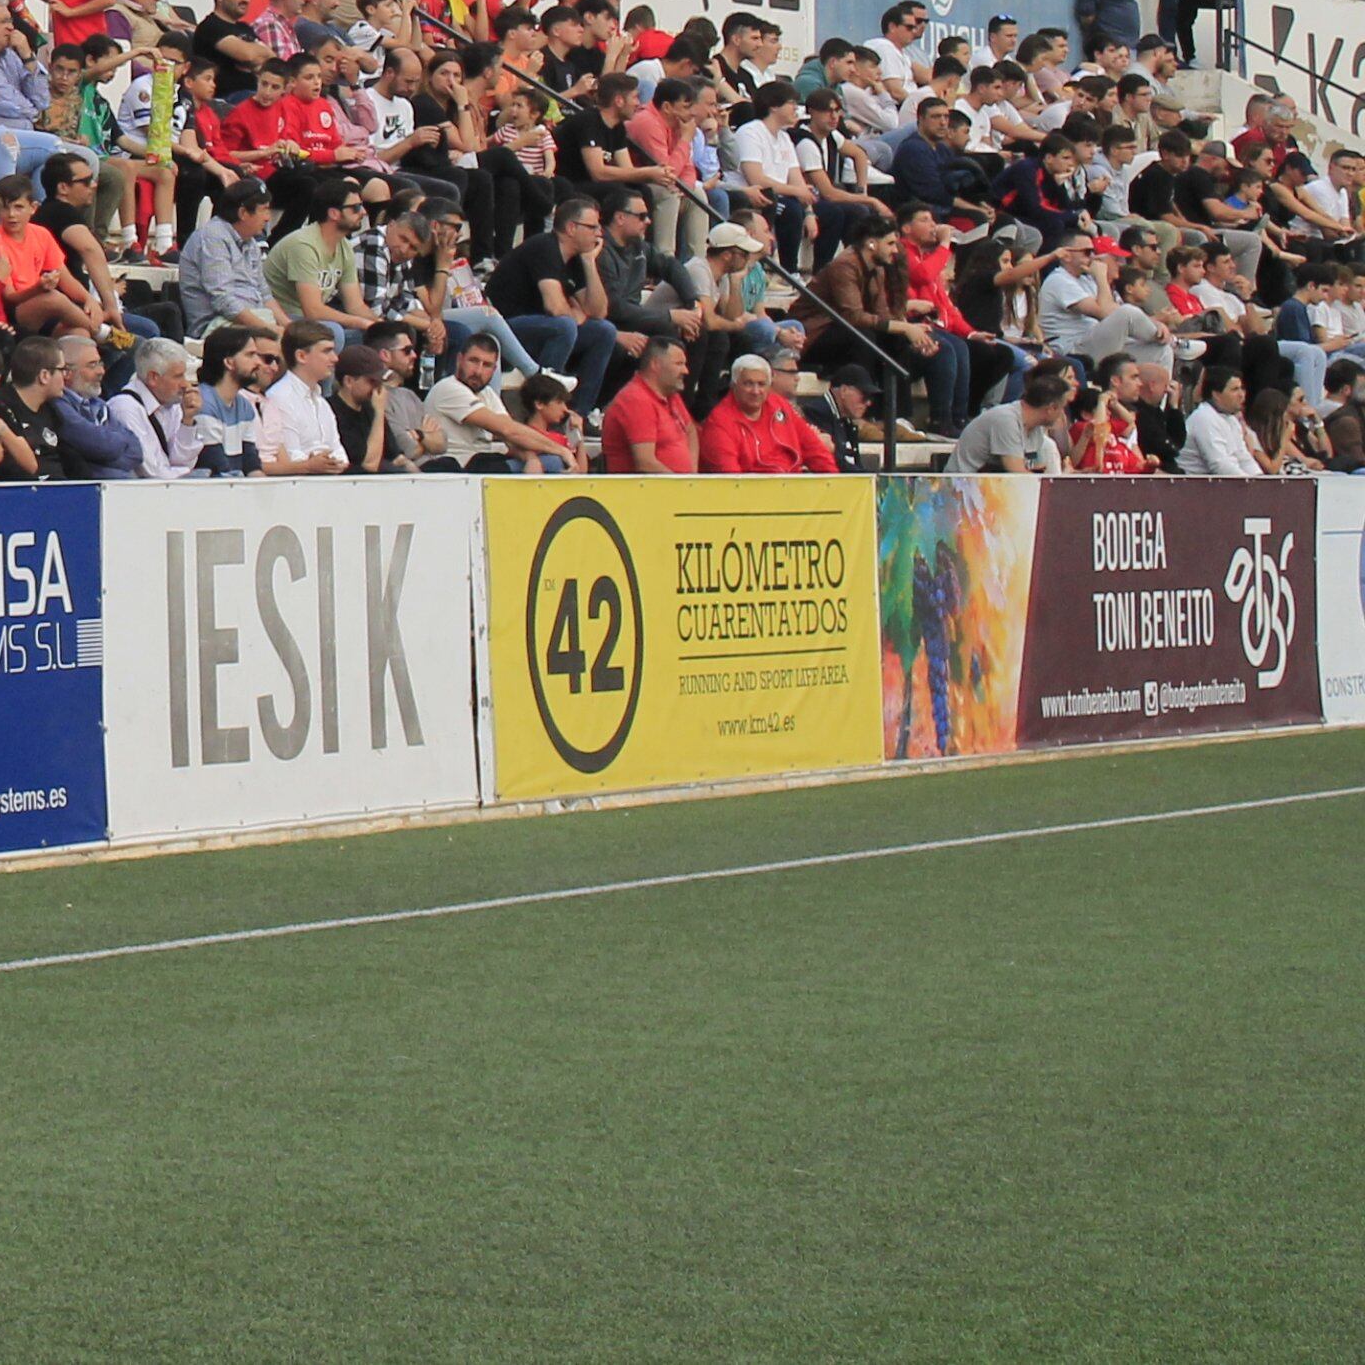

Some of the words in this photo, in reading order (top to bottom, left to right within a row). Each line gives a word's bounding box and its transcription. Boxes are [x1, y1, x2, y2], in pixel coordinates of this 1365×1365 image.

[675, 527, 845, 594] KILÓMETRO
[1092, 511, 1167, 572] BODEGA
[546, 575, 625, 694] 42
[677, 597, 848, 642] CUARENTAYDOS
[1093, 591, 1137, 653] TONI
[1140, 588, 1215, 650] BENEITO
[35, 622, 77, 672] S.L.
[679, 672, 731, 695] RUNNING
[733, 670, 757, 692] AND
[760, 668, 793, 689] SPORT
[820, 664, 849, 685] AREA
[1041, 686, 1141, 719] www.tonibeneito.com
[718, 713, 796, 737] www.km42.es
